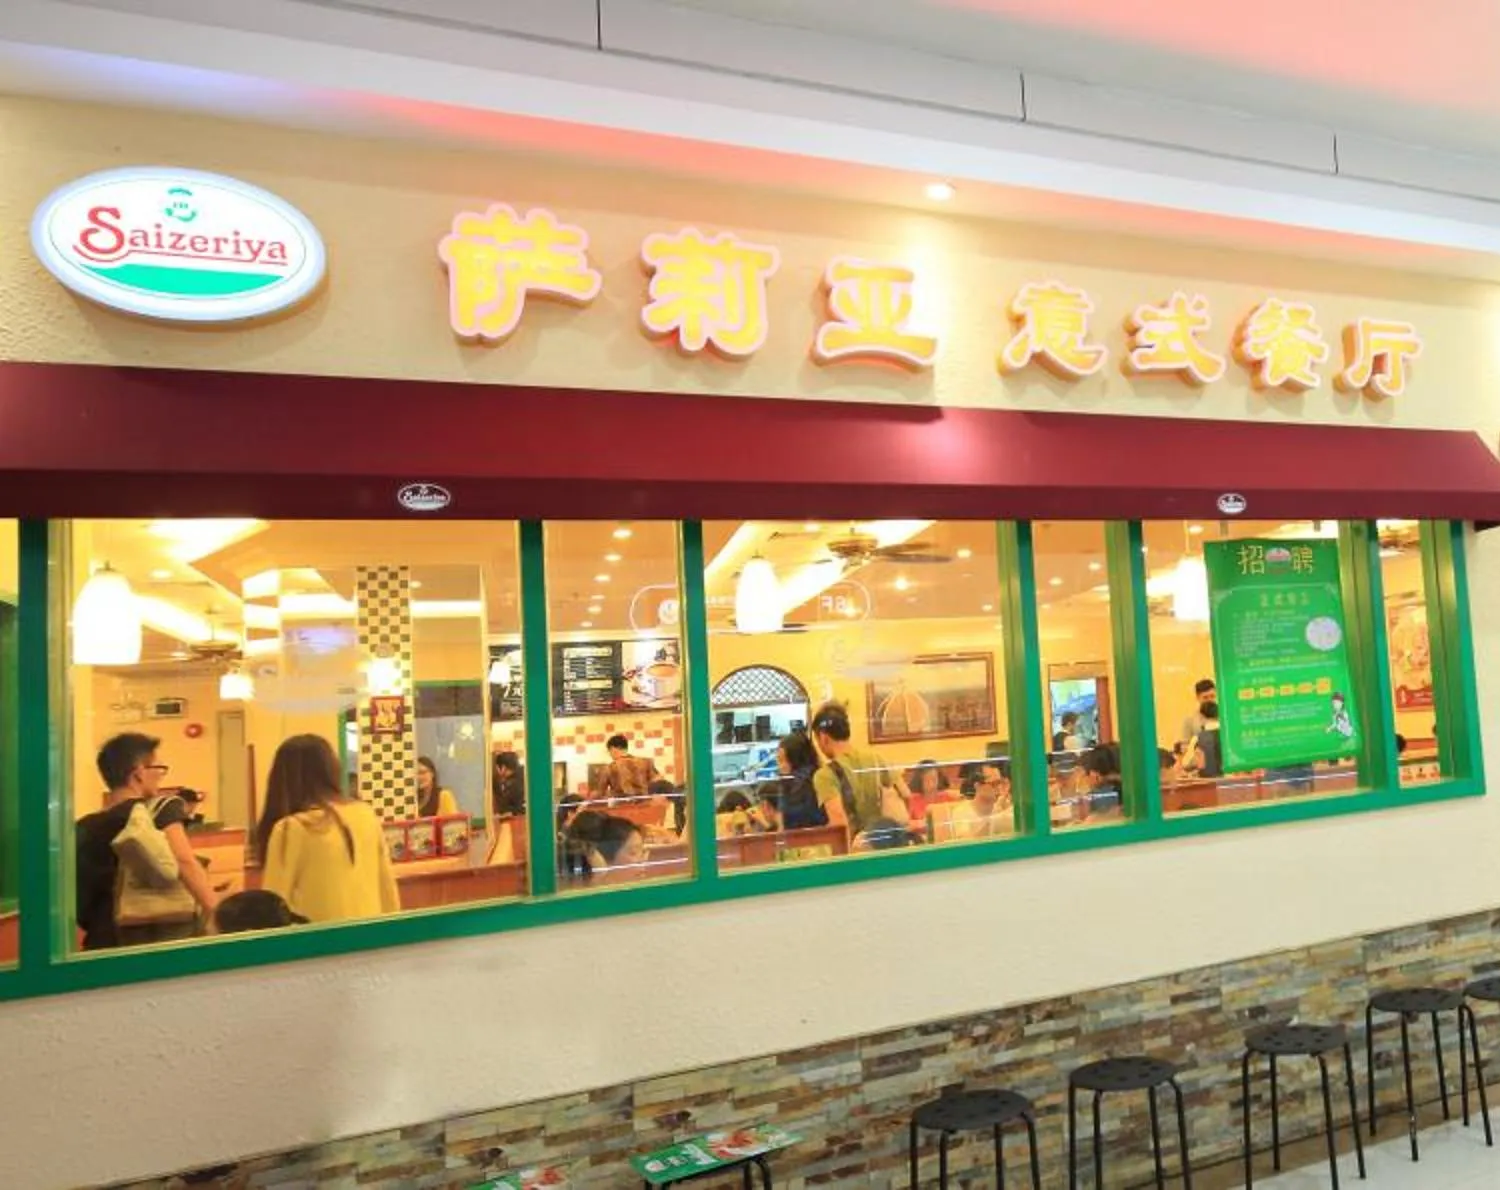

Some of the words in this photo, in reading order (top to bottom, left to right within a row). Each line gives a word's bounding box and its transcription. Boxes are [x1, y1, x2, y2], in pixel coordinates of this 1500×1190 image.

[78, 206, 288, 264] Saizeriya
[438, 204, 938, 368] 萨莉亚
[1000, 281, 1422, 397] 意式餐厅
